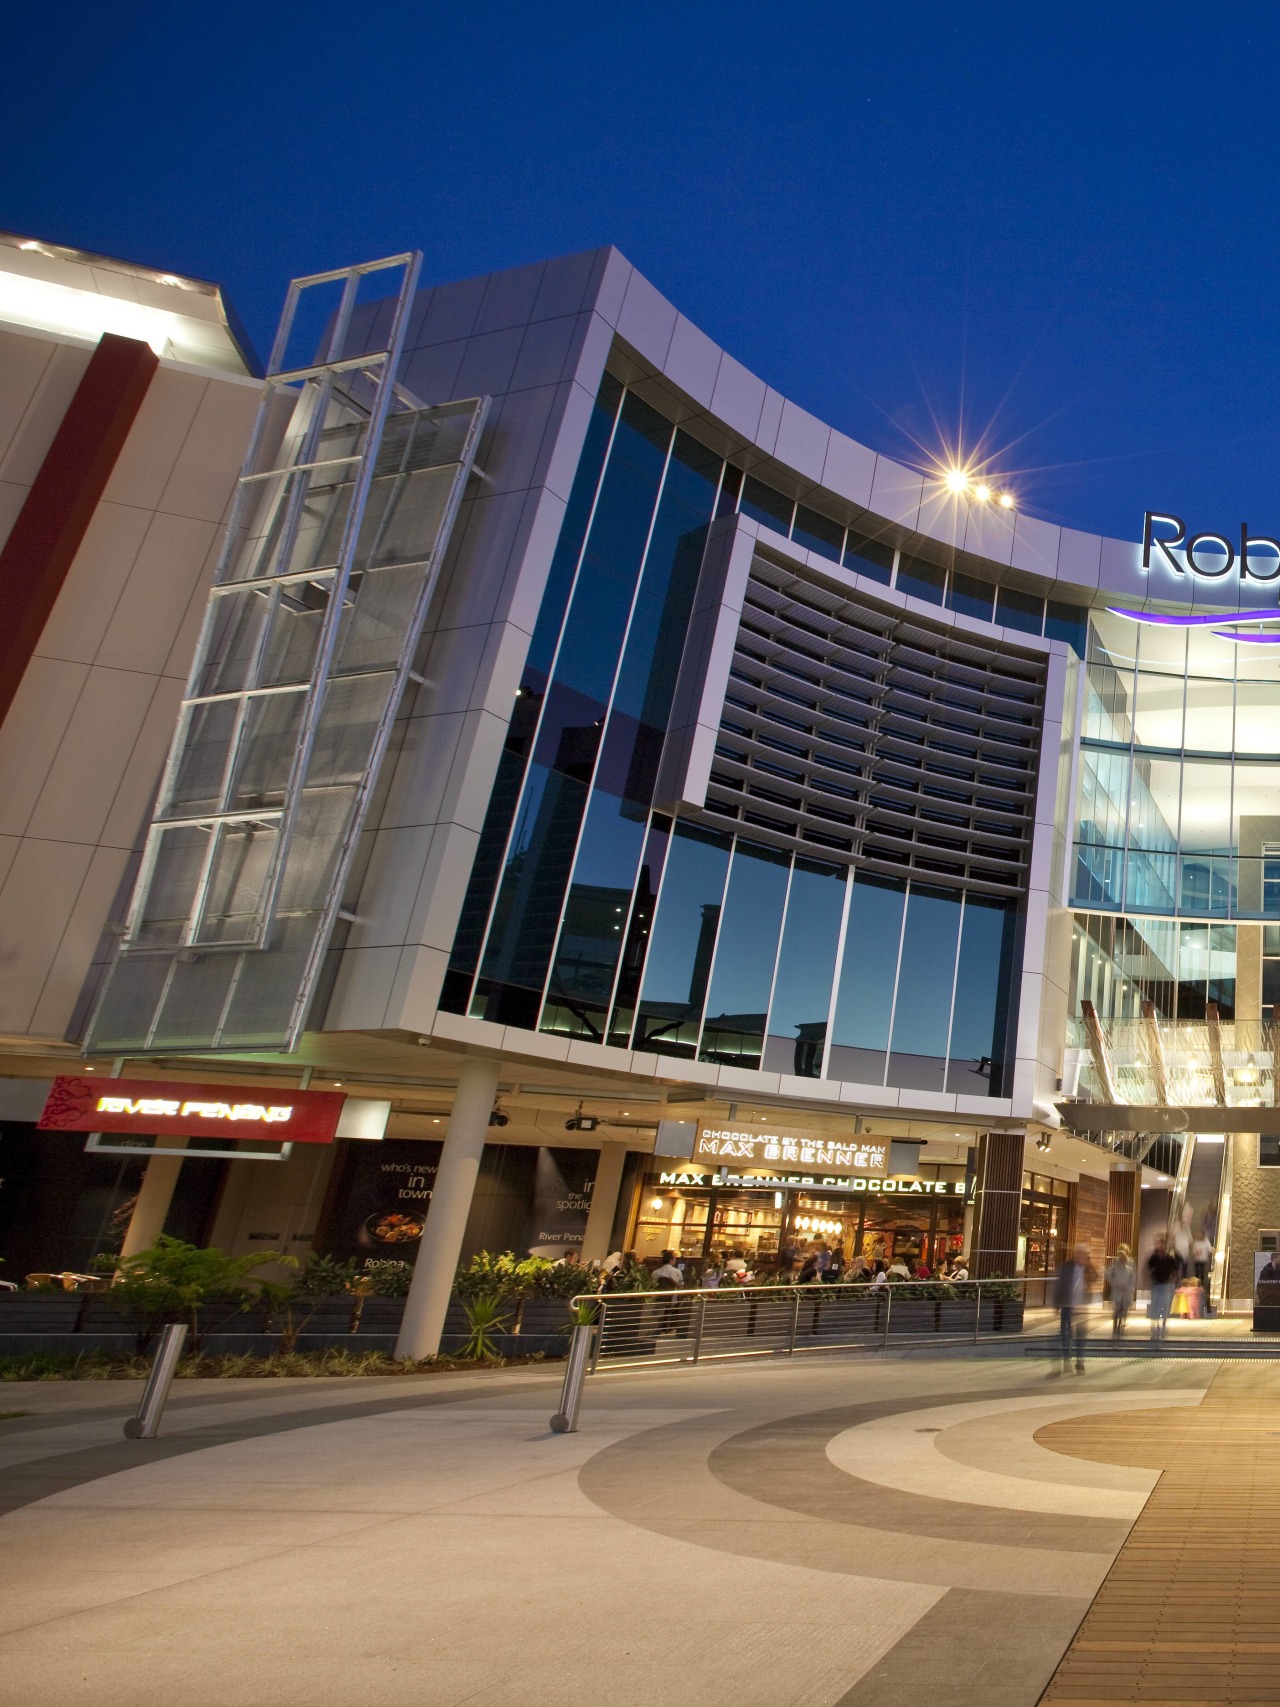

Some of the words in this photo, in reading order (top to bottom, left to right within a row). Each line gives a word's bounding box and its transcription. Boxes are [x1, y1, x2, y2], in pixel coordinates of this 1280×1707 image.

[702, 1129, 779, 1143] CHOCOLATE
[782, 1136, 798, 1147] BY
[800, 1138, 824, 1149] THE
[827, 1141, 858, 1152] BALD
[861, 1144, 886, 1154] MAN
[699, 1138, 754, 1157] MAX
[764, 1144, 886, 1168] BRENNER
[381, 1163, 411, 1173] who's
[407, 1173, 425, 1188] in
[659, 1172, 705, 1186] MAX
[398, 1188, 433, 1199] town
[568, 1192, 583, 1200] the
[539, 1232, 562, 1240] River
